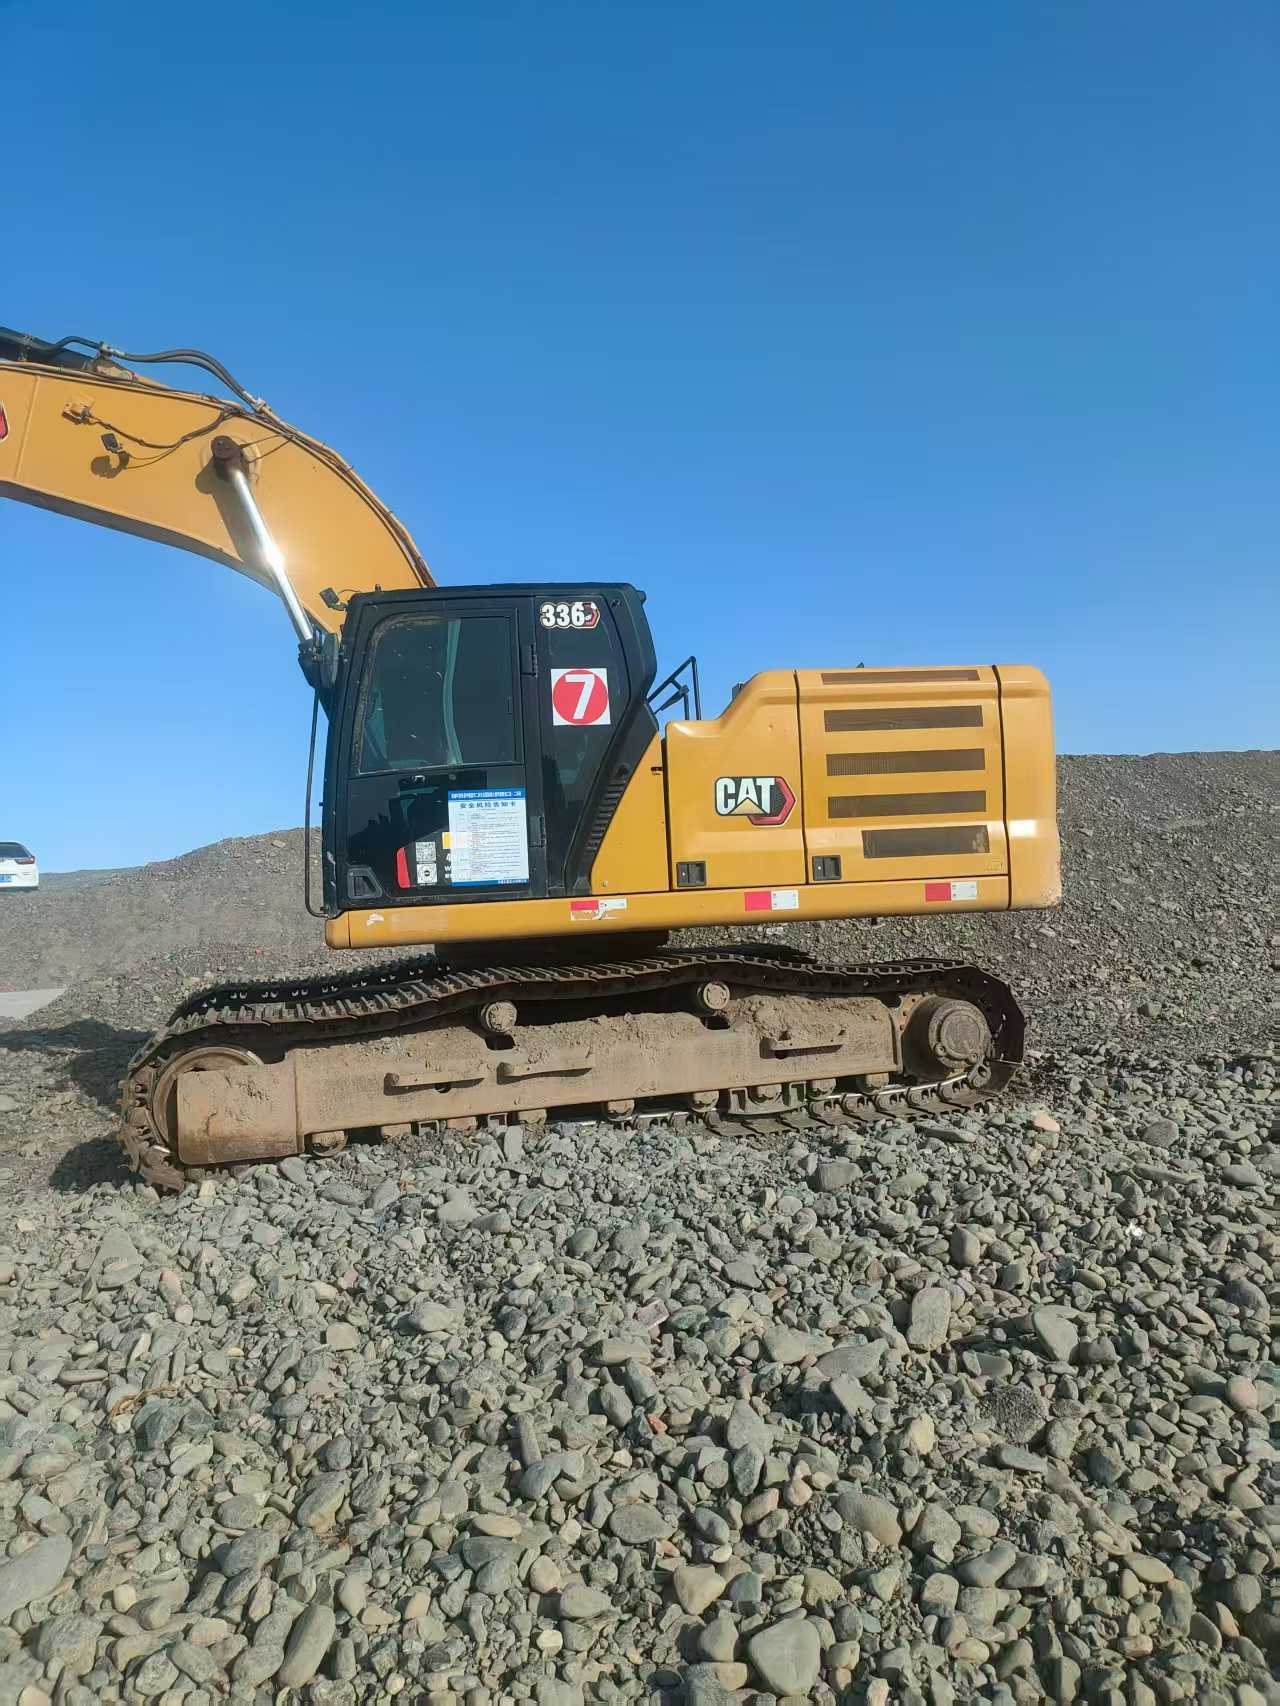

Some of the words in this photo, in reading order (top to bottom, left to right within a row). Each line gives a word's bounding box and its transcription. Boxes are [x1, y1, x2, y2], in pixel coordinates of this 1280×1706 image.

[541, 603, 585, 627] 336
[564, 673, 595, 720] 7
[715, 777, 776, 815] CAT
